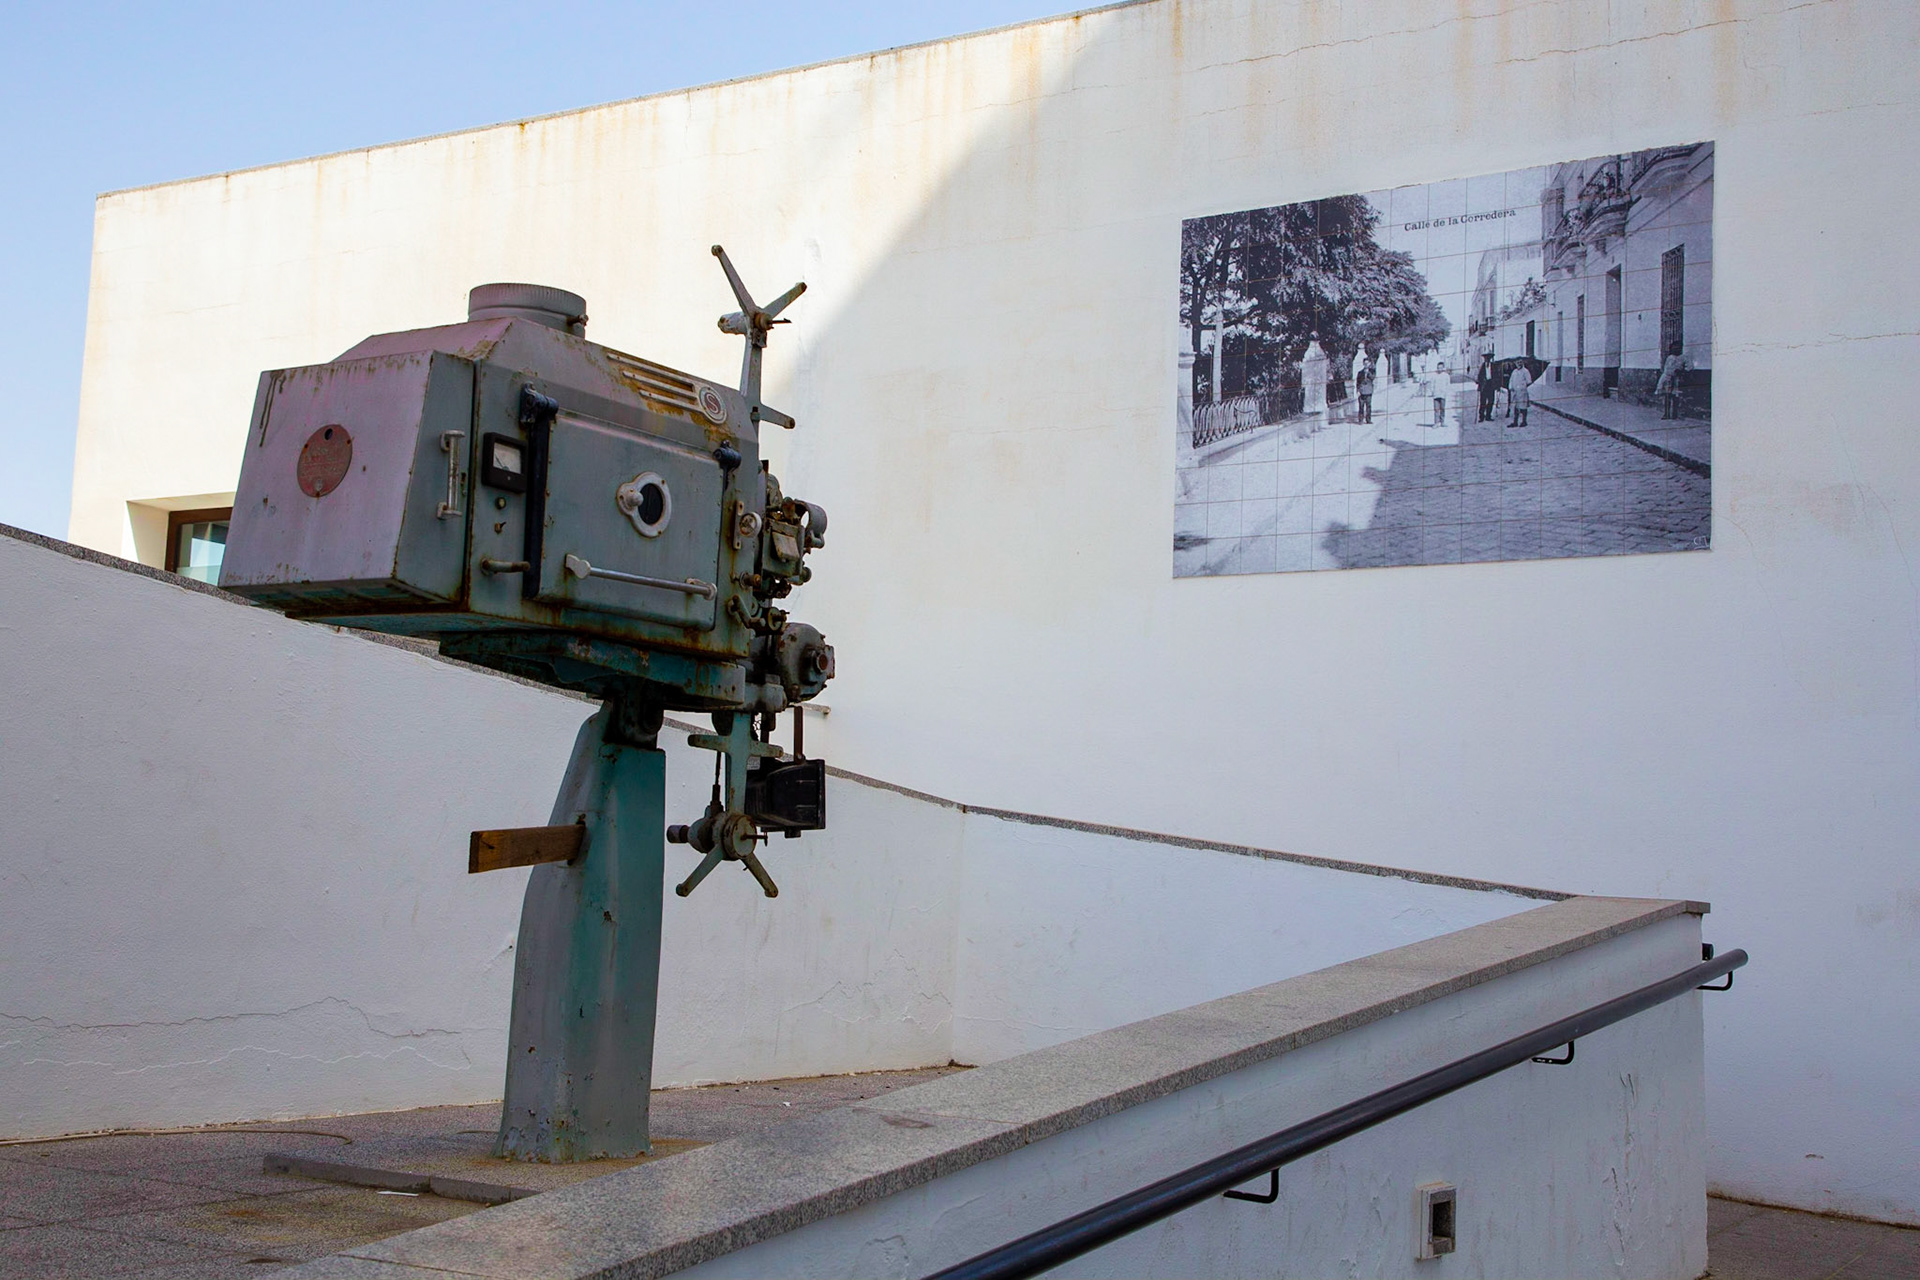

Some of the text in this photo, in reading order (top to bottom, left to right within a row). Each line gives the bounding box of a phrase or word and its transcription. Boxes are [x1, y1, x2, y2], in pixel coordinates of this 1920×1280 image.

[1404, 209, 1516, 231] Calle de la Corredera
